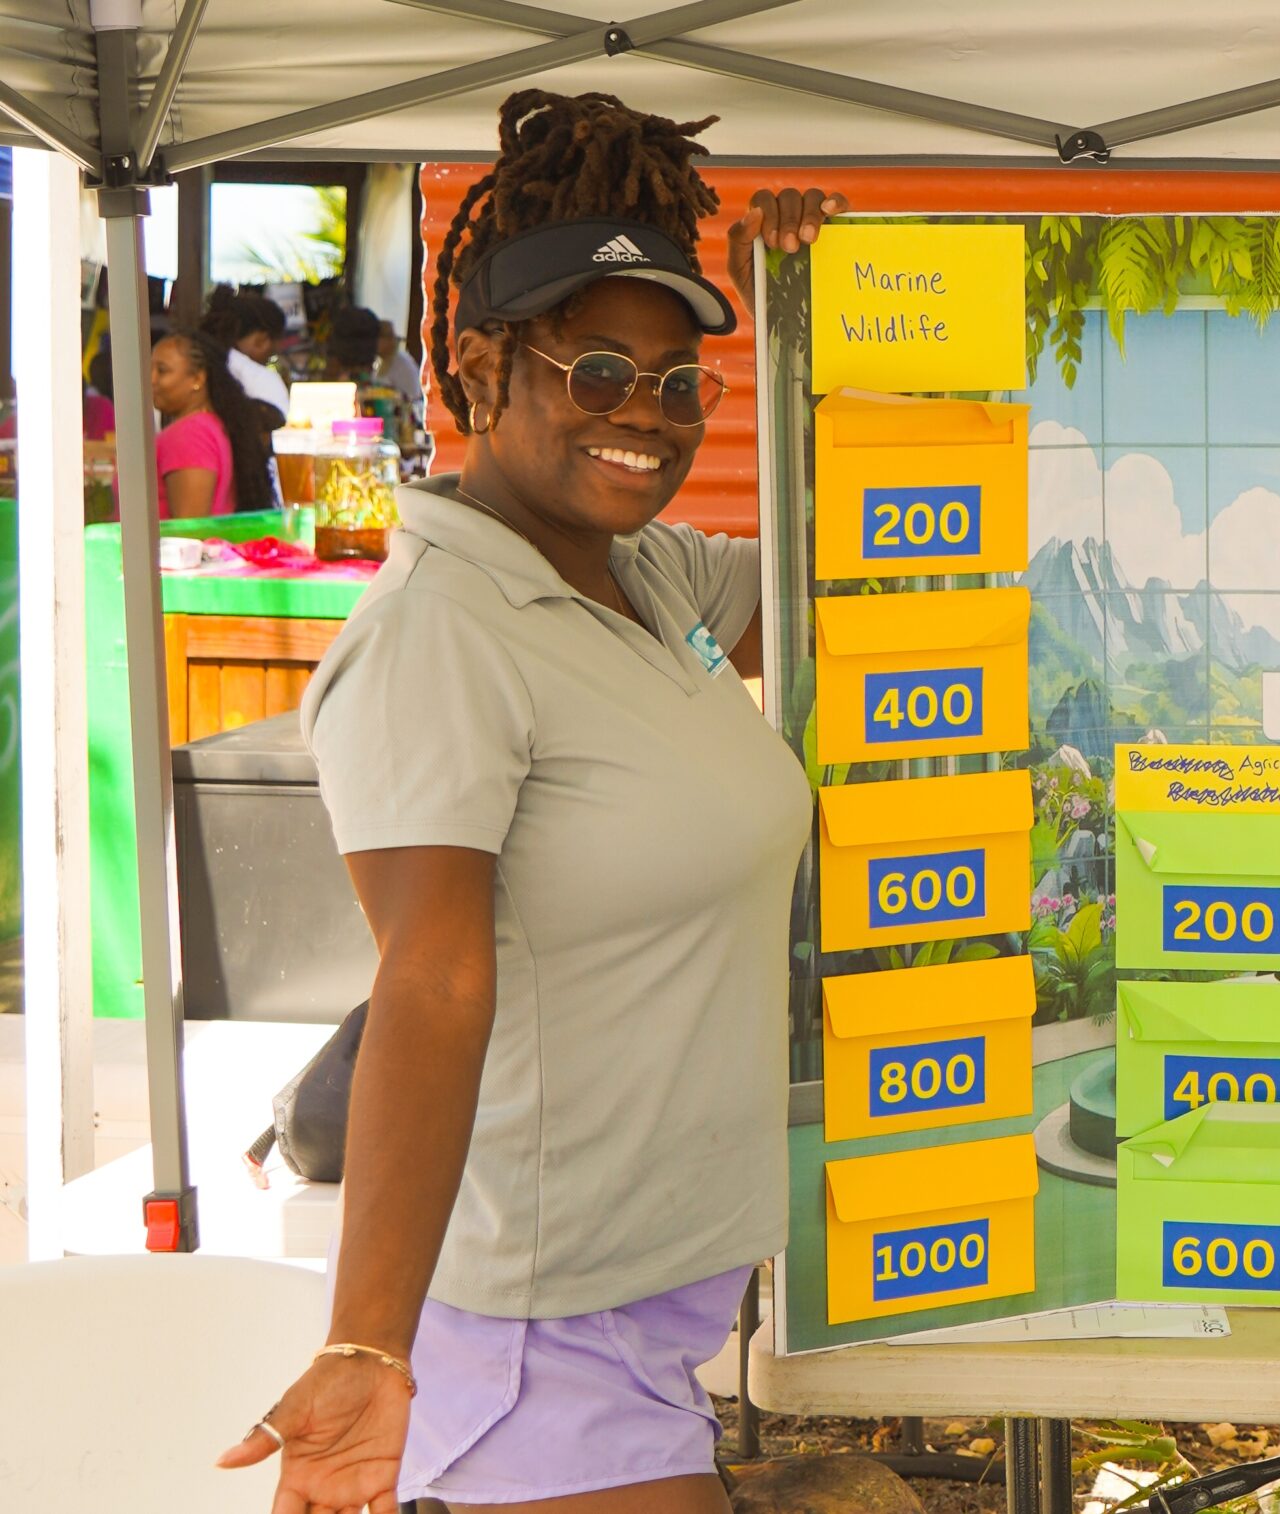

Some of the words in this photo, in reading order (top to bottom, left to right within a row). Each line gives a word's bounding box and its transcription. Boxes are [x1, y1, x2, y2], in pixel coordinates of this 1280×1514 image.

[855, 262, 947, 294] Marine
[841, 313, 949, 343] Wildlife
[873, 502, 970, 546] 200
[874, 684, 973, 729] 400
[878, 866, 976, 914] 600
[1173, 900, 1274, 943] 200
[880, 1054, 975, 1102] 800
[1173, 1071, 1277, 1112] 400
[877, 1233, 985, 1281] 1000
[1172, 1236, 1275, 1279] 600
